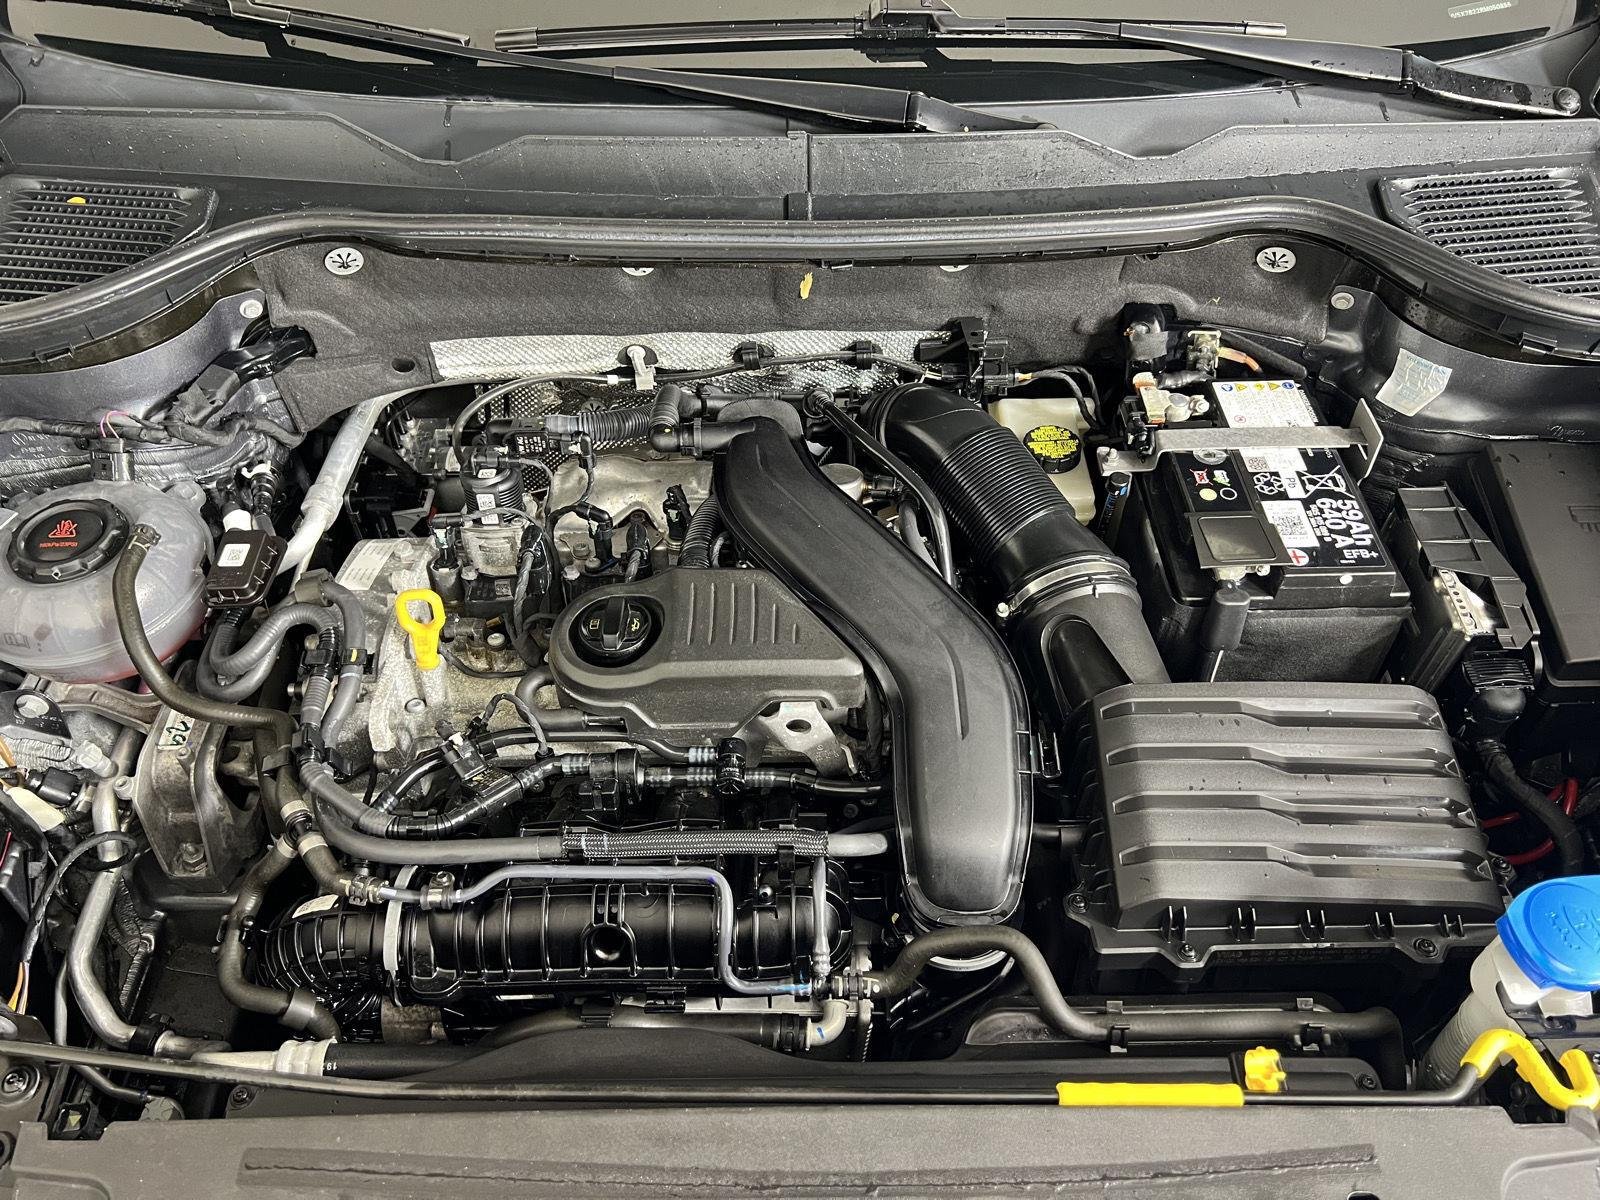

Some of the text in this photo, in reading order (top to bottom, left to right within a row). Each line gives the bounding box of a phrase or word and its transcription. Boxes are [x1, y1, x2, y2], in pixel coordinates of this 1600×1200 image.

[1316, 498, 1347, 530] 640
[1337, 499, 1374, 546] 59Ah
[1330, 533, 1355, 549] A
[1343, 549, 1379, 559] EFB+
